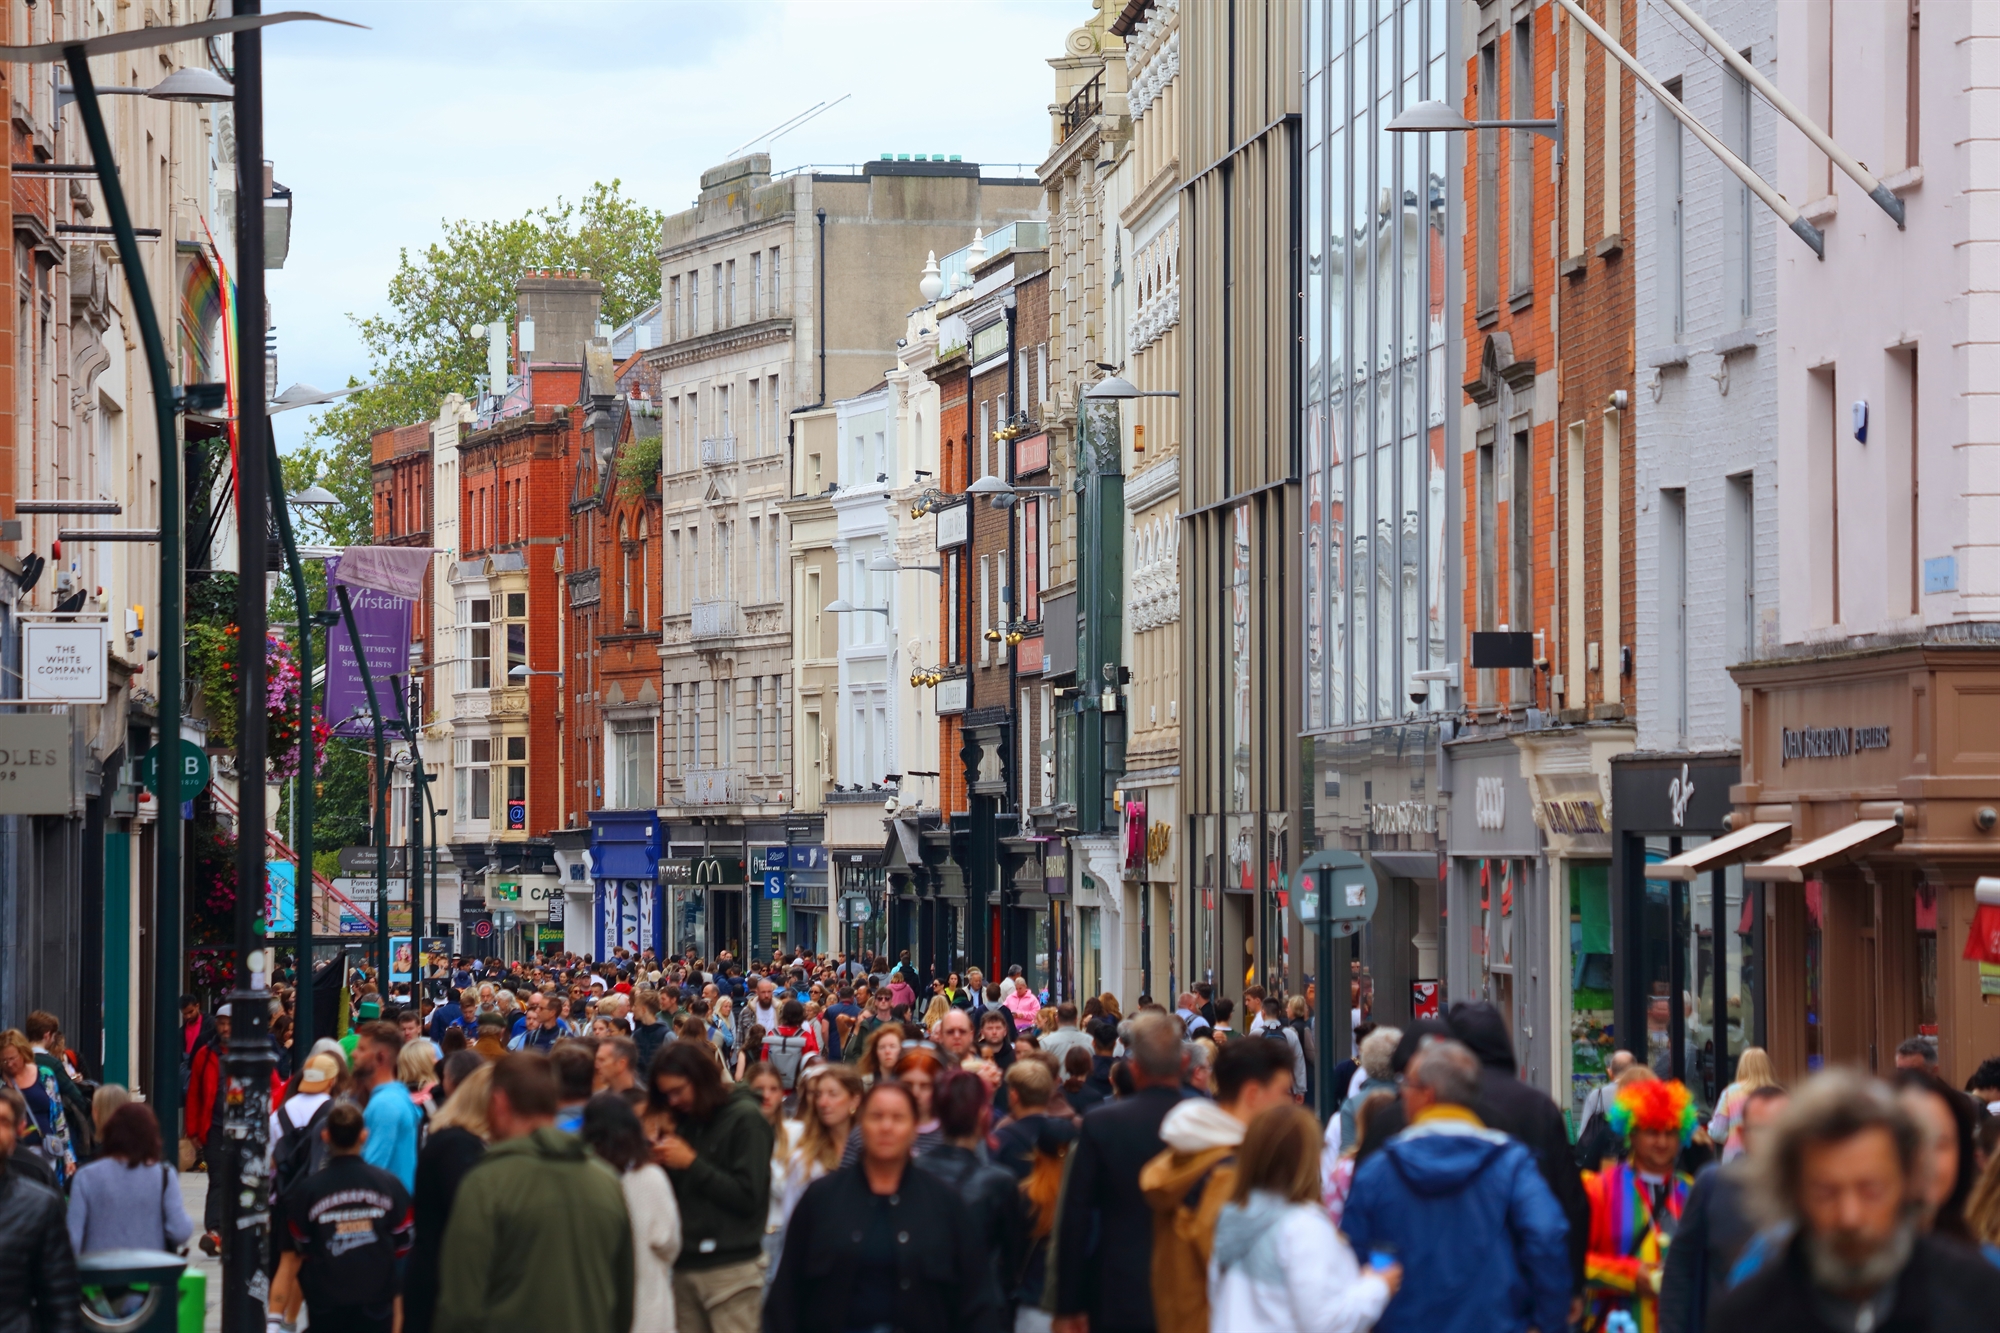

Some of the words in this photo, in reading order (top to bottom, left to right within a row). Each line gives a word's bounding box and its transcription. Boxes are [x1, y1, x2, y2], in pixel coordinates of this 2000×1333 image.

[55, 645, 76, 654] THE
[46, 656, 81, 664] WHITE
[37, 666, 92, 675] COMPANY
[1780, 726, 1804, 768] JOHN
[1804, 725, 1850, 758] BRERETON
[350, 879, 398, 887] Powersurt
